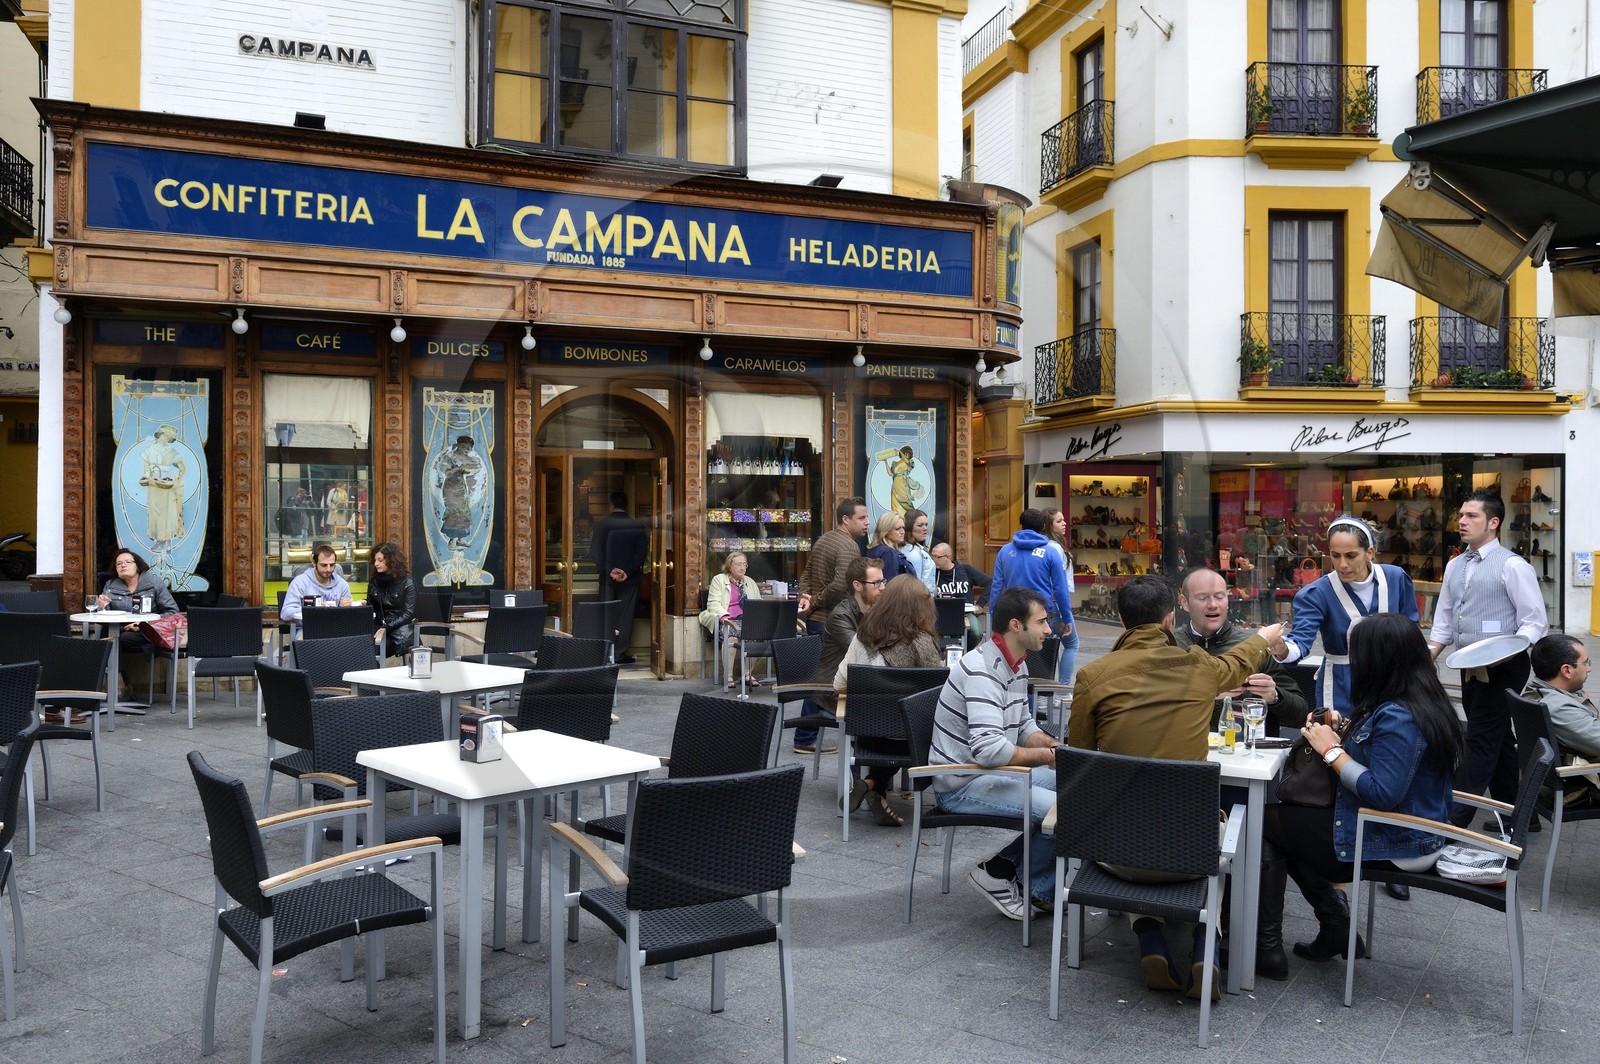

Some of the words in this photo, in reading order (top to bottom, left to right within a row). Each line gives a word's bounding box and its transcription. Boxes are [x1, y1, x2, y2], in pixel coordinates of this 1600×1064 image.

[239, 34, 374, 67] CAMPANA
[154, 178, 375, 225] CONFITERIA
[417, 193, 486, 244] LA
[512, 205, 752, 266] CAMPANA
[789, 237, 941, 275] HELADERIA
[546, 250, 595, 266] FUNDADA
[602, 255, 626, 269] 1885
[144, 326, 176, 342] THE
[296, 332, 341, 349] CAFÉ
[427, 341, 489, 357] DULCES
[564, 346, 648, 363] BOMBONES
[724, 356, 806, 373] CARAMELOS
[866, 364, 935, 379] PANELLETES
[1290, 425, 1343, 452] Pilar
[1347, 417, 1410, 451] Burgos
[1569, 430, 1576, 441] 3
